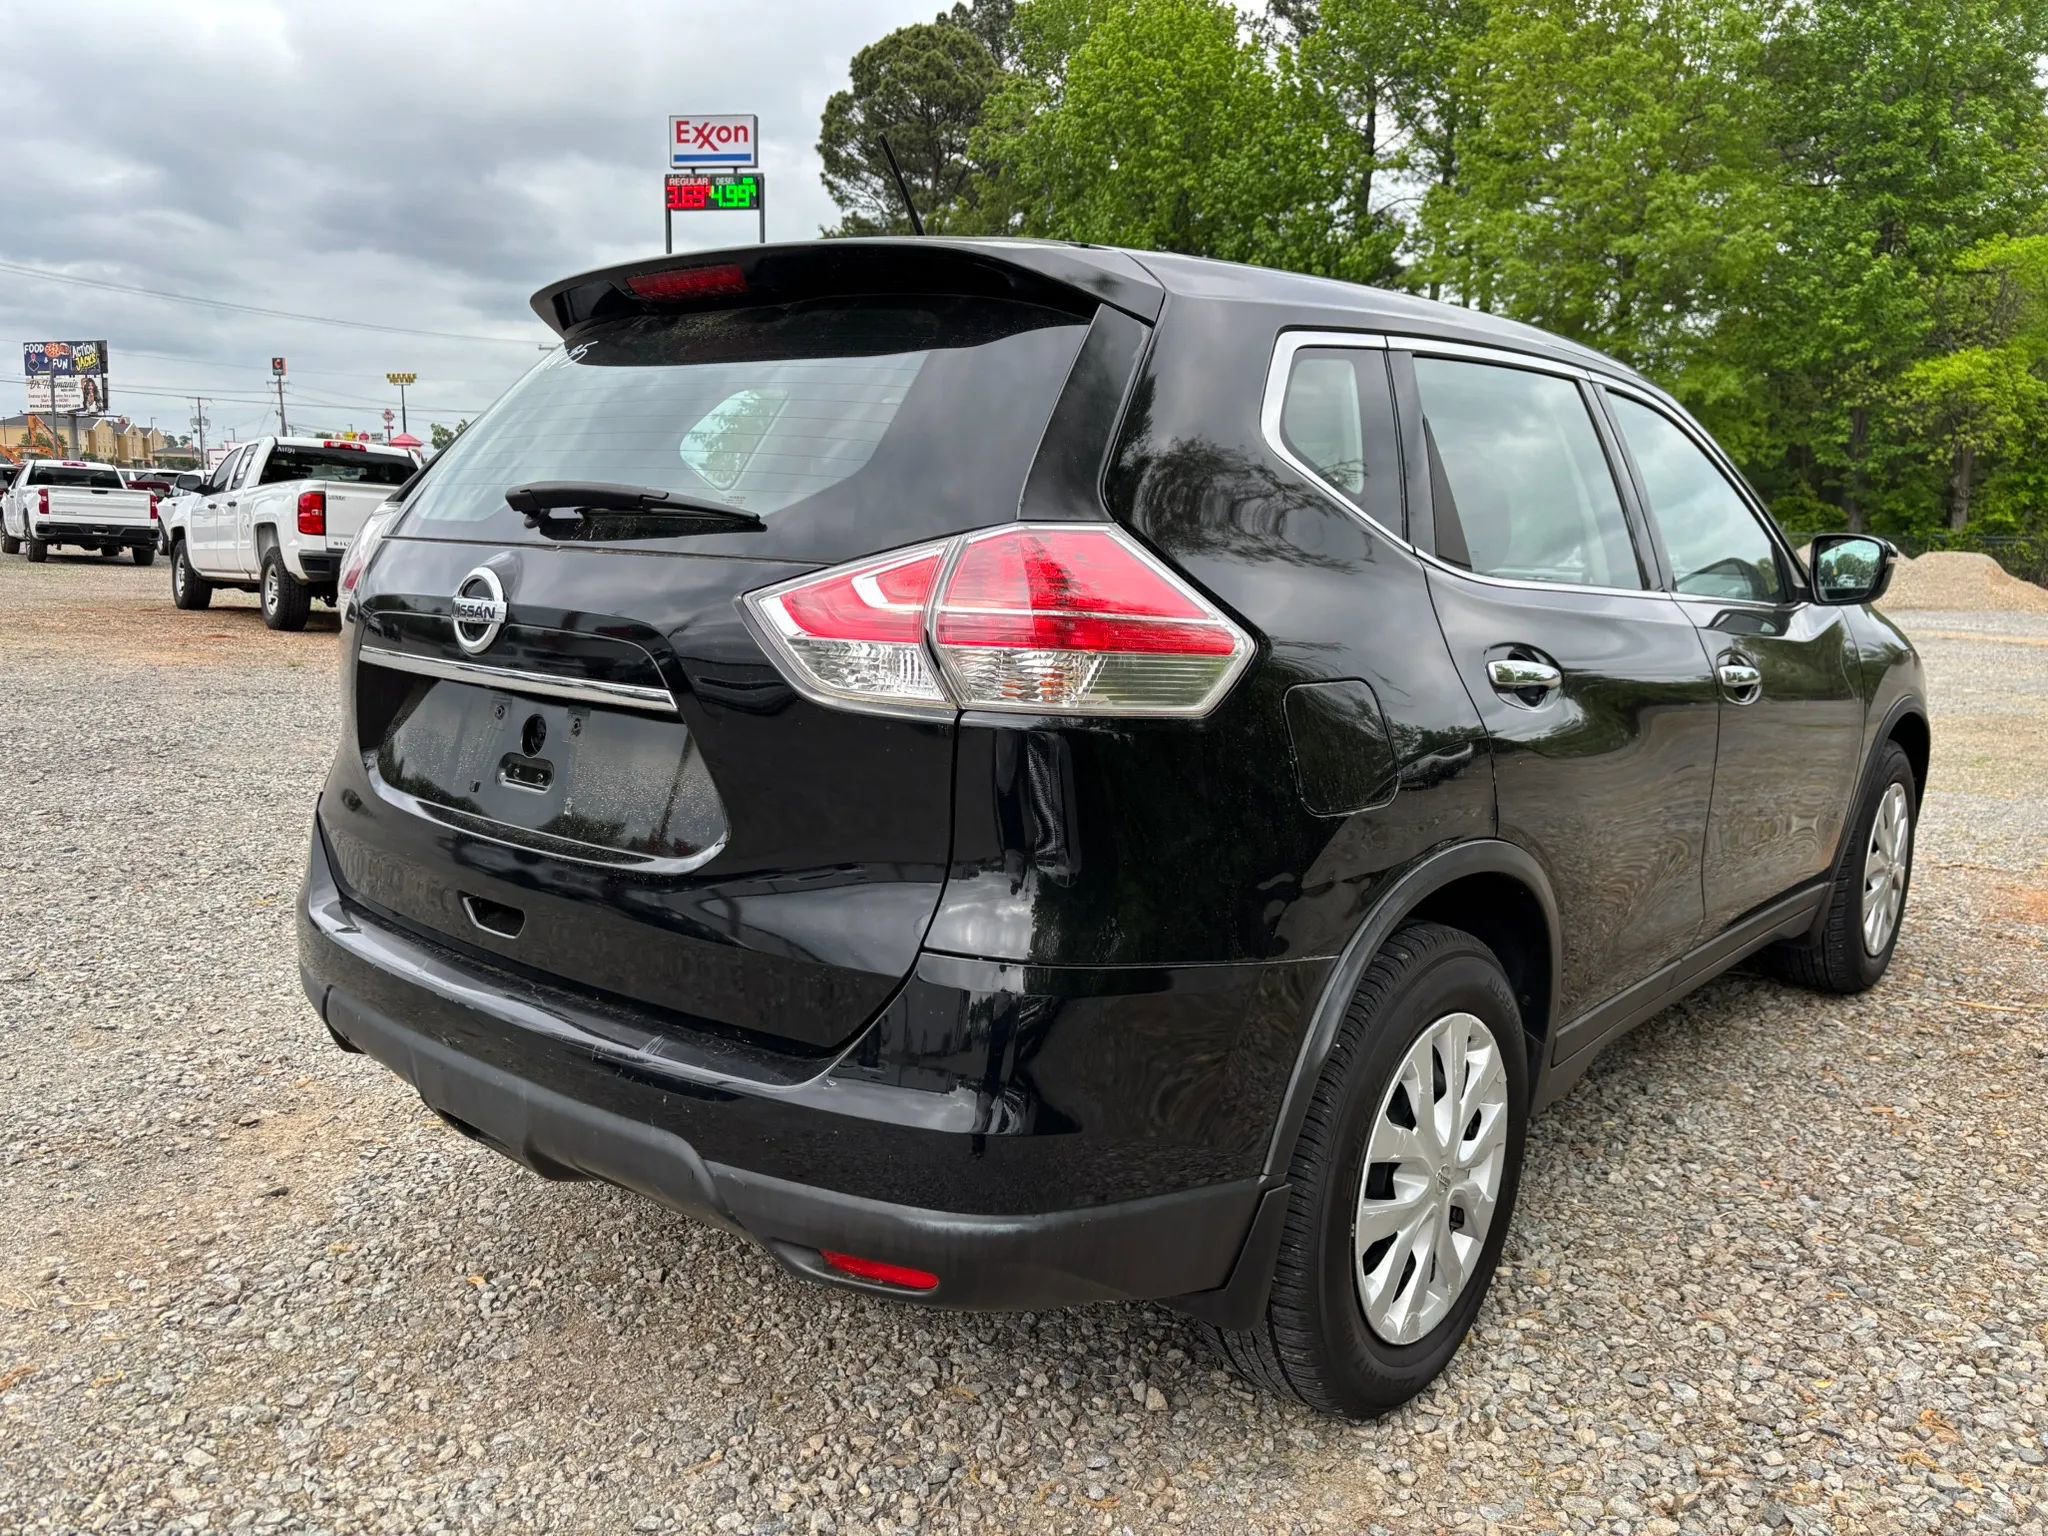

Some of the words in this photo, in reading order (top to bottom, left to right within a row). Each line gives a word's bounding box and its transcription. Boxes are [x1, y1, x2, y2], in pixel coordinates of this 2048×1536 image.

[676, 121, 749, 151] Exxon
[24, 344, 44, 355] FOOD
[72, 342, 97, 359] ACTION
[52, 358, 69, 370] FUN
[75, 353, 97, 371] JACKS
[452, 601, 495, 619] NISSAN
